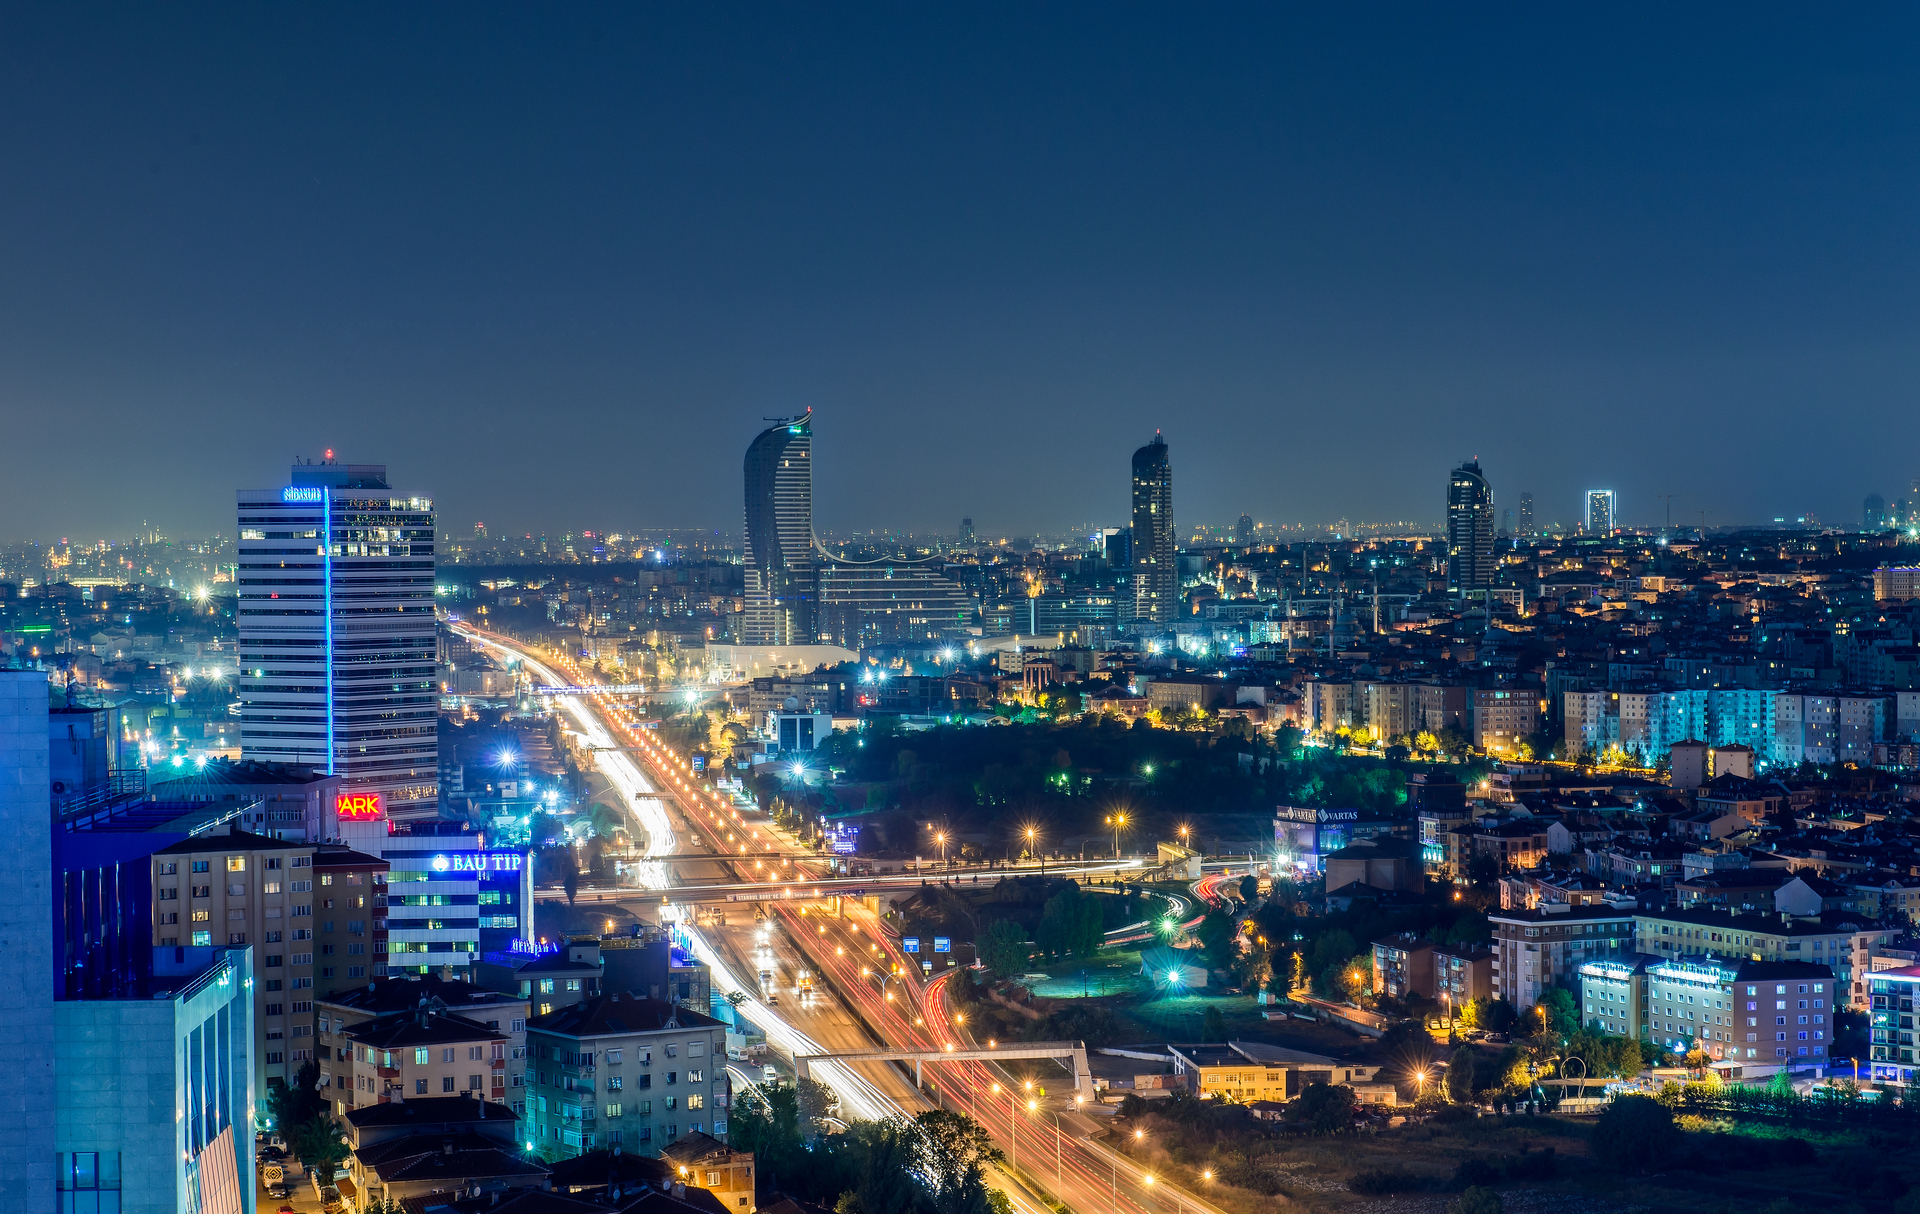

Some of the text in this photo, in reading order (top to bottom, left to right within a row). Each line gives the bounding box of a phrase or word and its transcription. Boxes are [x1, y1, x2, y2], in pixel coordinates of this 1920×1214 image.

[1329, 812, 1358, 820] VARTAS
[453, 854, 521, 871] BAU TIP
